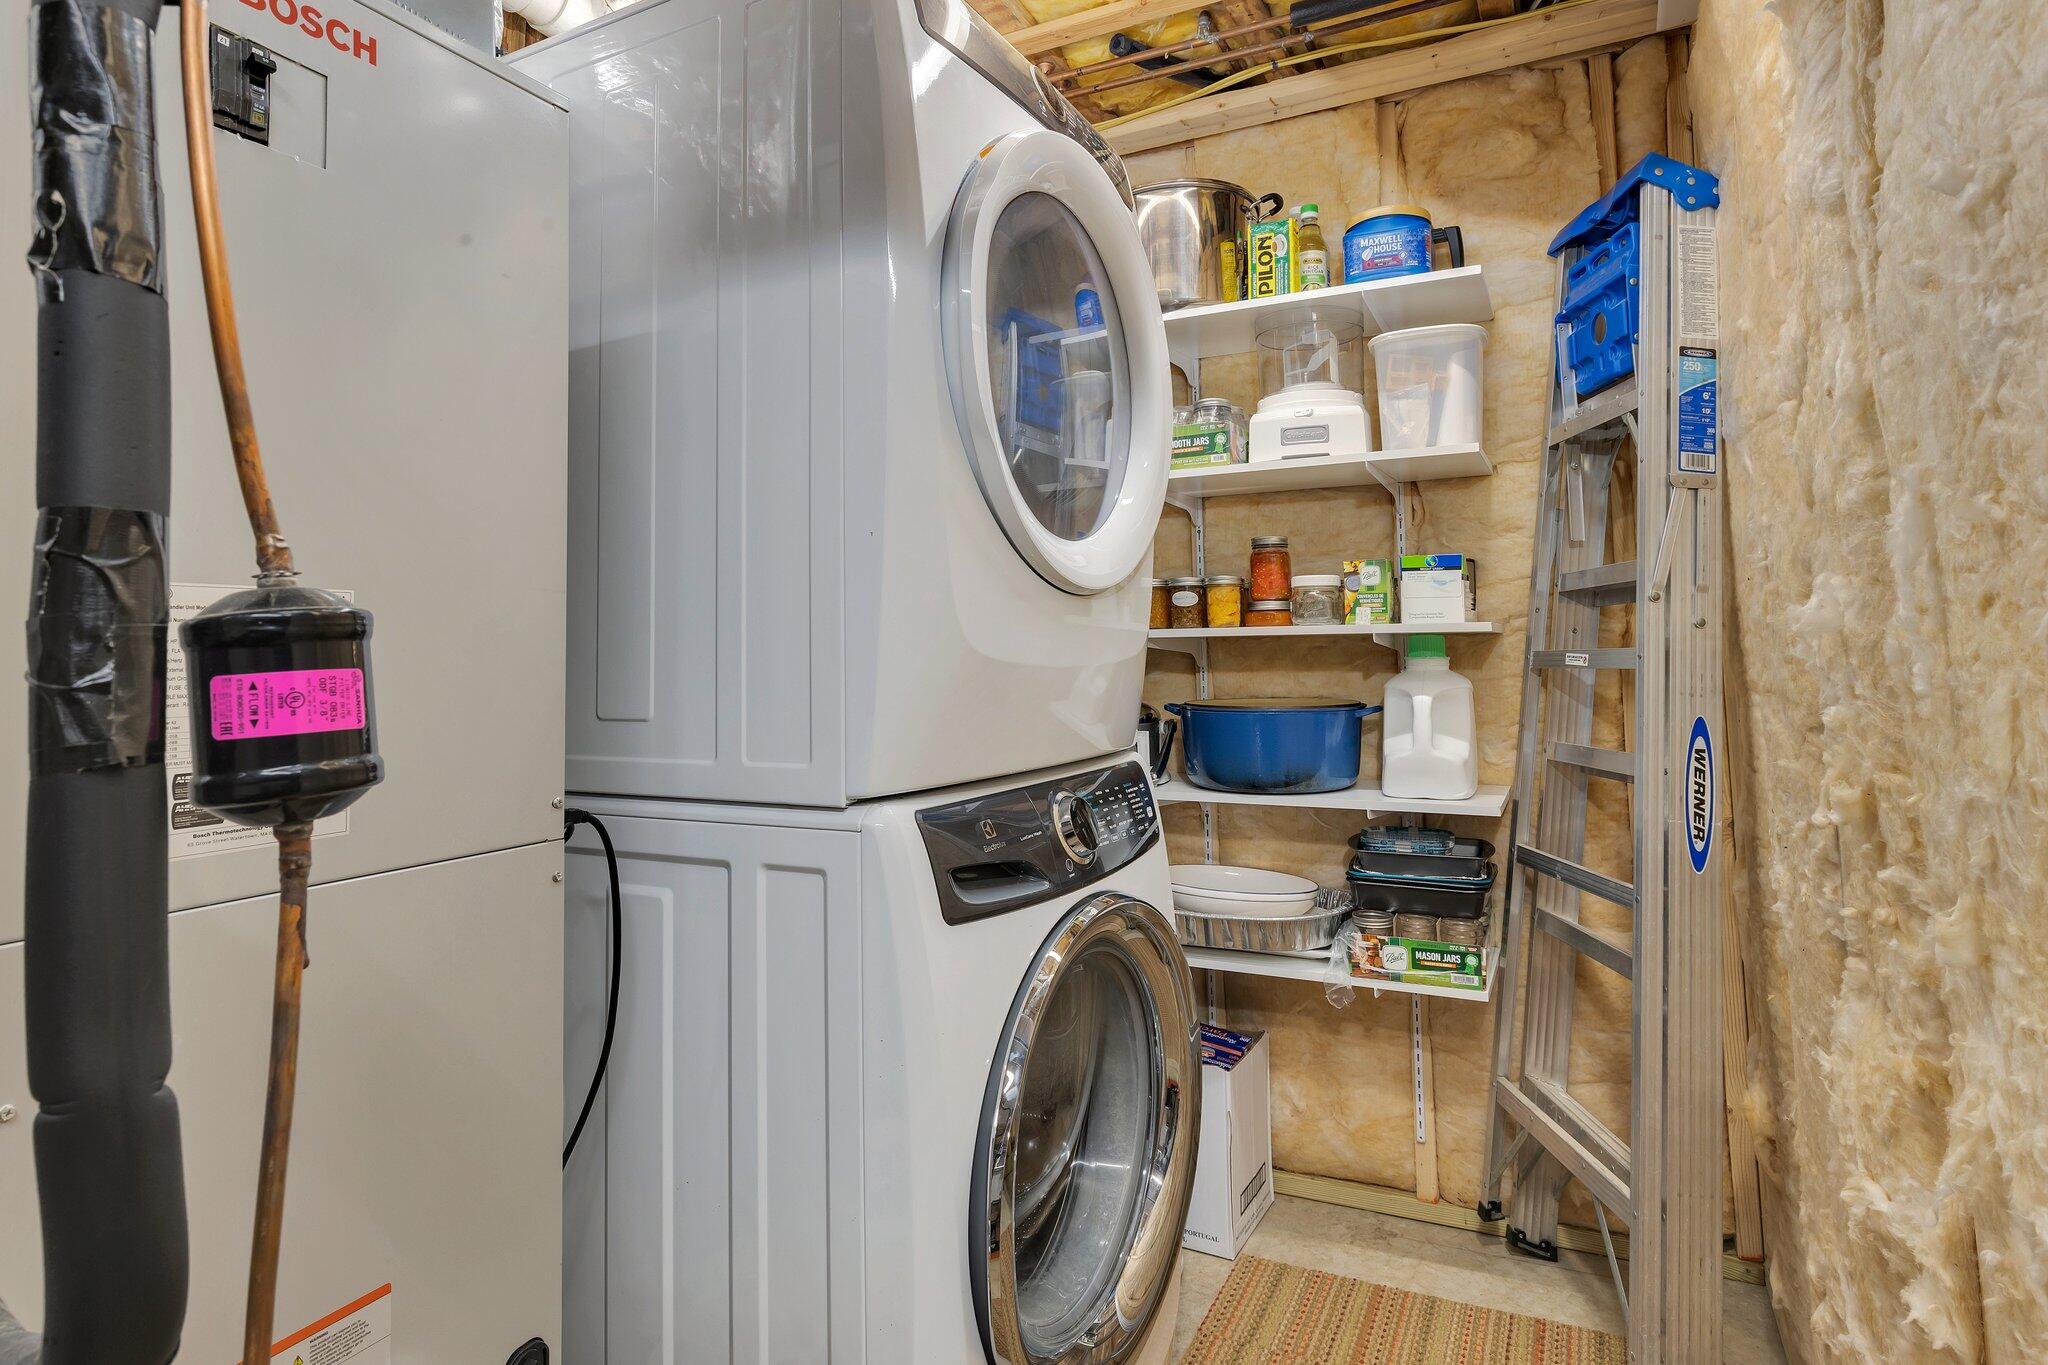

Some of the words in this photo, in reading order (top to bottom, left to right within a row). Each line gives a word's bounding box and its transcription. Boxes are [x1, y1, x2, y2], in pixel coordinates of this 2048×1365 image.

[1360, 235, 1402, 248] MAXWELL
[1374, 242, 1402, 254] HOUSE
[1258, 235, 1274, 295] PILON
[1682, 361, 1700, 372] 250
[1193, 436, 1210, 446] JARS
[1362, 570, 1378, 580] Ball
[248, 692, 259, 716] FLOW
[1694, 748, 1706, 843] WERNER
[1386, 952, 1404, 964] Ball
[1416, 950, 1442, 962] MASON
[1442, 953, 1461, 964] JARS
[1184, 1228, 1220, 1242] PORTUGAL
